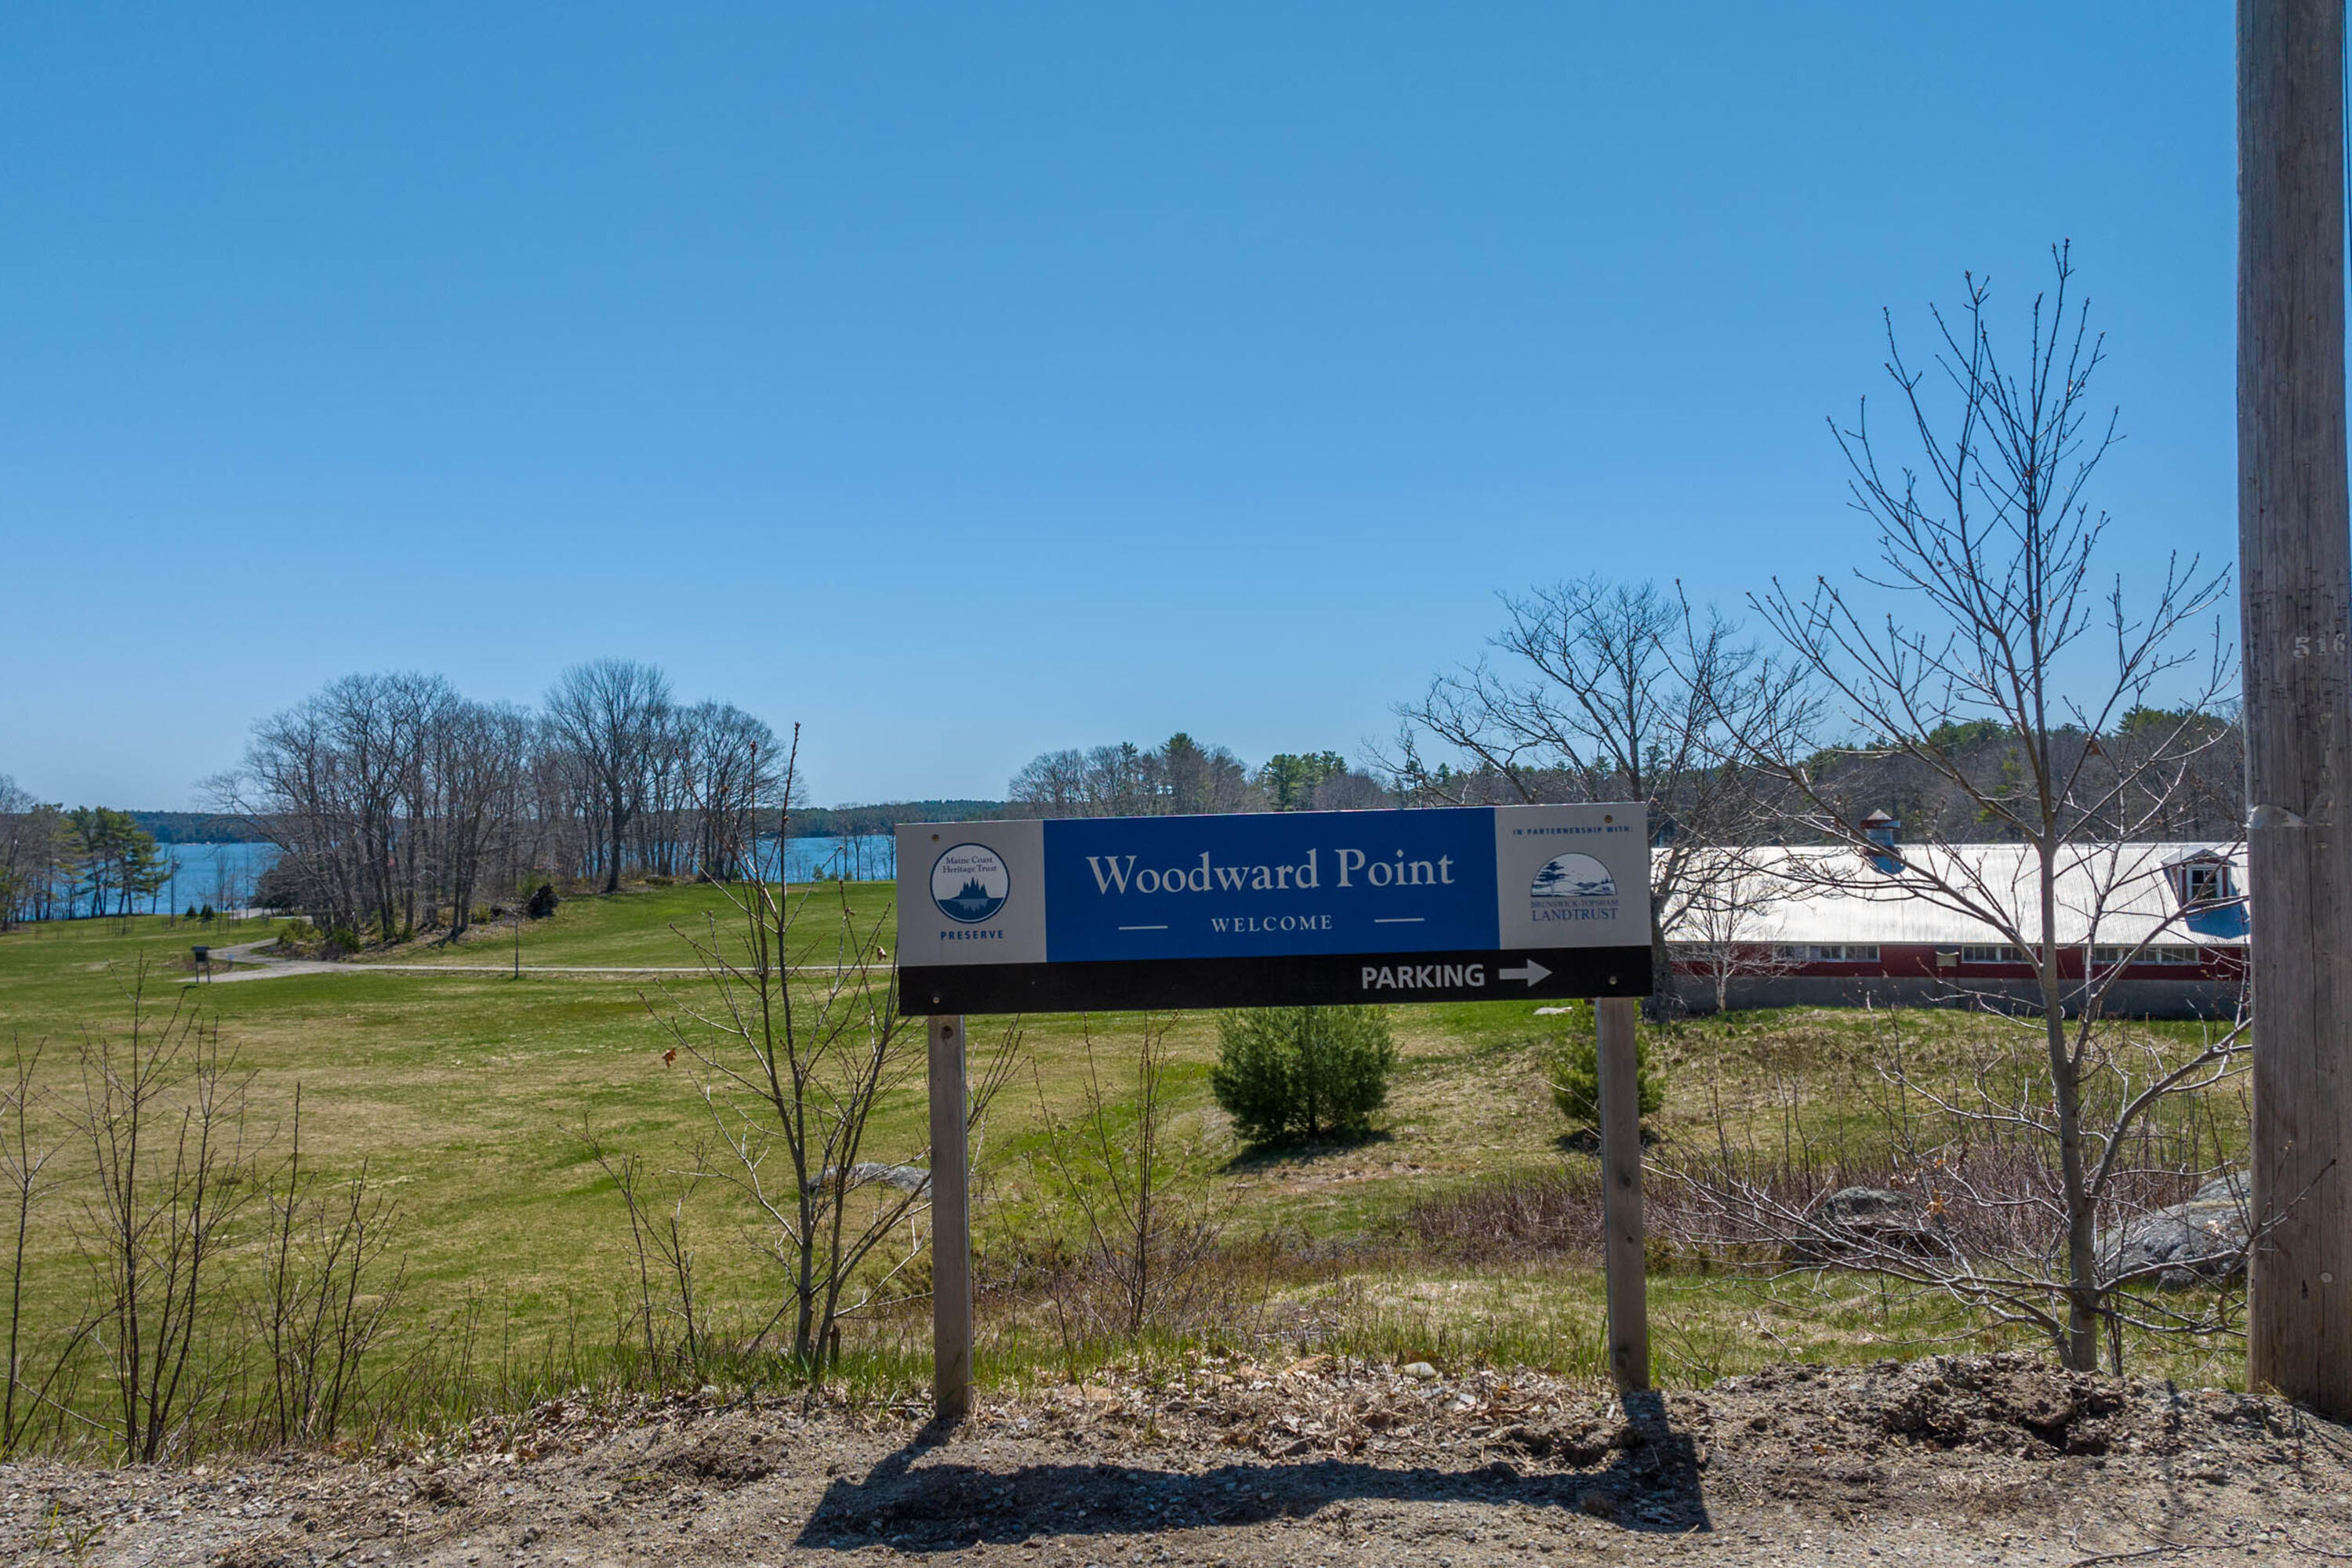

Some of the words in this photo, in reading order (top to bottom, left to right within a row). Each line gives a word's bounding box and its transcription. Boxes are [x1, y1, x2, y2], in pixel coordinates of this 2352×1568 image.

[1513, 828, 1523, 837] IN
[946, 856, 970, 865] Maine
[971, 855, 993, 864] Coast
[942, 865, 976, 873] Heritage
[977, 864, 997, 873] Trust
[1087, 848, 1320, 895] Woodward
[1334, 848, 1456, 888] Point
[1210, 914, 1333, 933] WELCOME
[940, 929, 1004, 941] PRESERVE
[1361, 963, 1486, 990] PARKING
